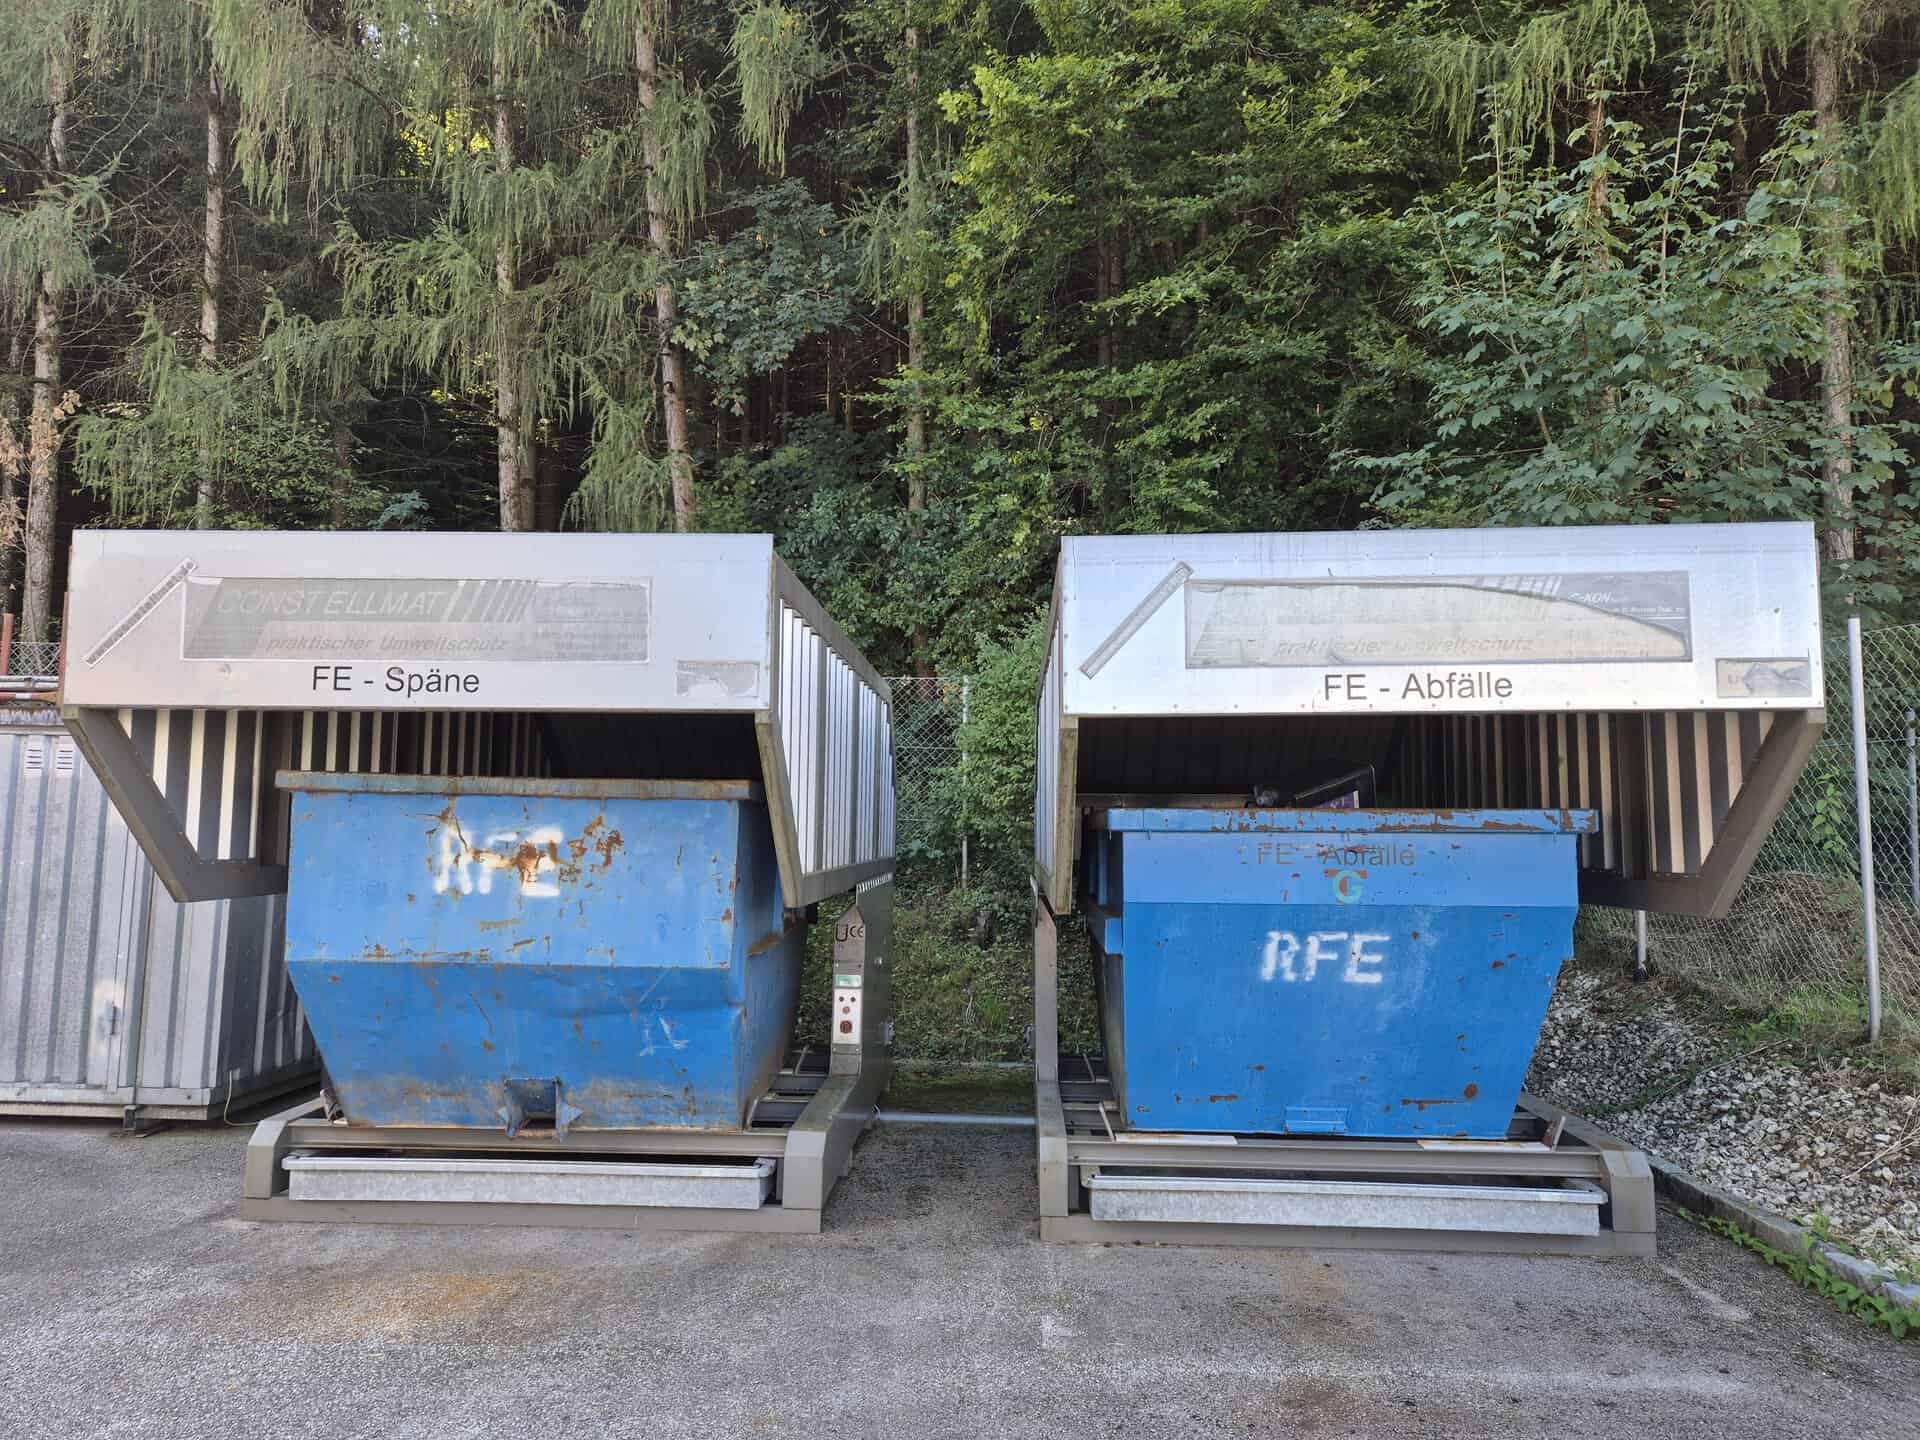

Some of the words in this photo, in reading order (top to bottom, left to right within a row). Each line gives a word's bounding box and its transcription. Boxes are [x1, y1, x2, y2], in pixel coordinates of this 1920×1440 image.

[312, 665, 353, 691] FE
[385, 666, 480, 698] Späne
[1324, 674, 1368, 700] FE
[1401, 671, 1513, 699] Abfälle
[1261, 931, 1391, 984] RFE
